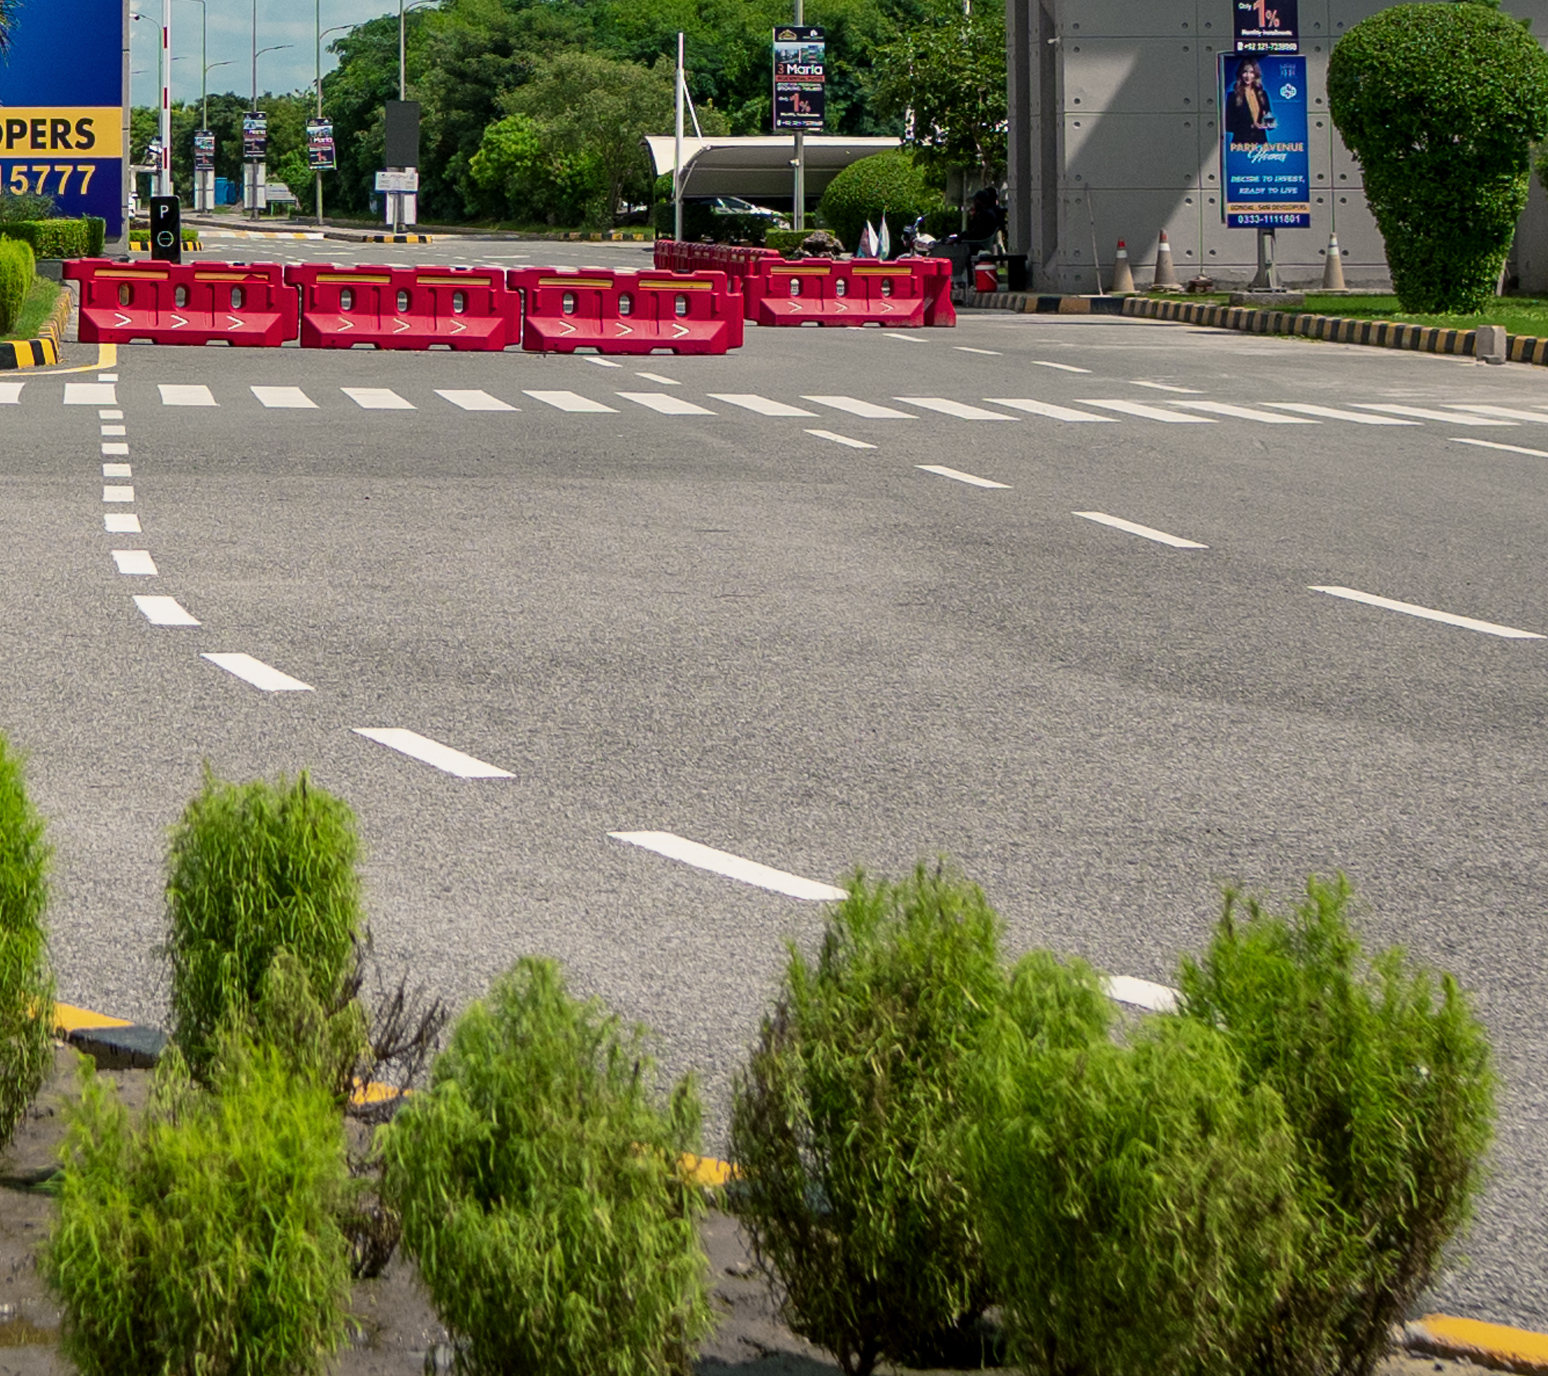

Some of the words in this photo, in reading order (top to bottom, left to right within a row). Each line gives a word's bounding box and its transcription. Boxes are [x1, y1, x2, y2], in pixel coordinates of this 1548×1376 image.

[786, 63, 824, 76] Marla
[1230, 142, 1259, 152] PARK
[1262, 142, 1304, 152] AVENUE
[159, 204, 169, 219] P
